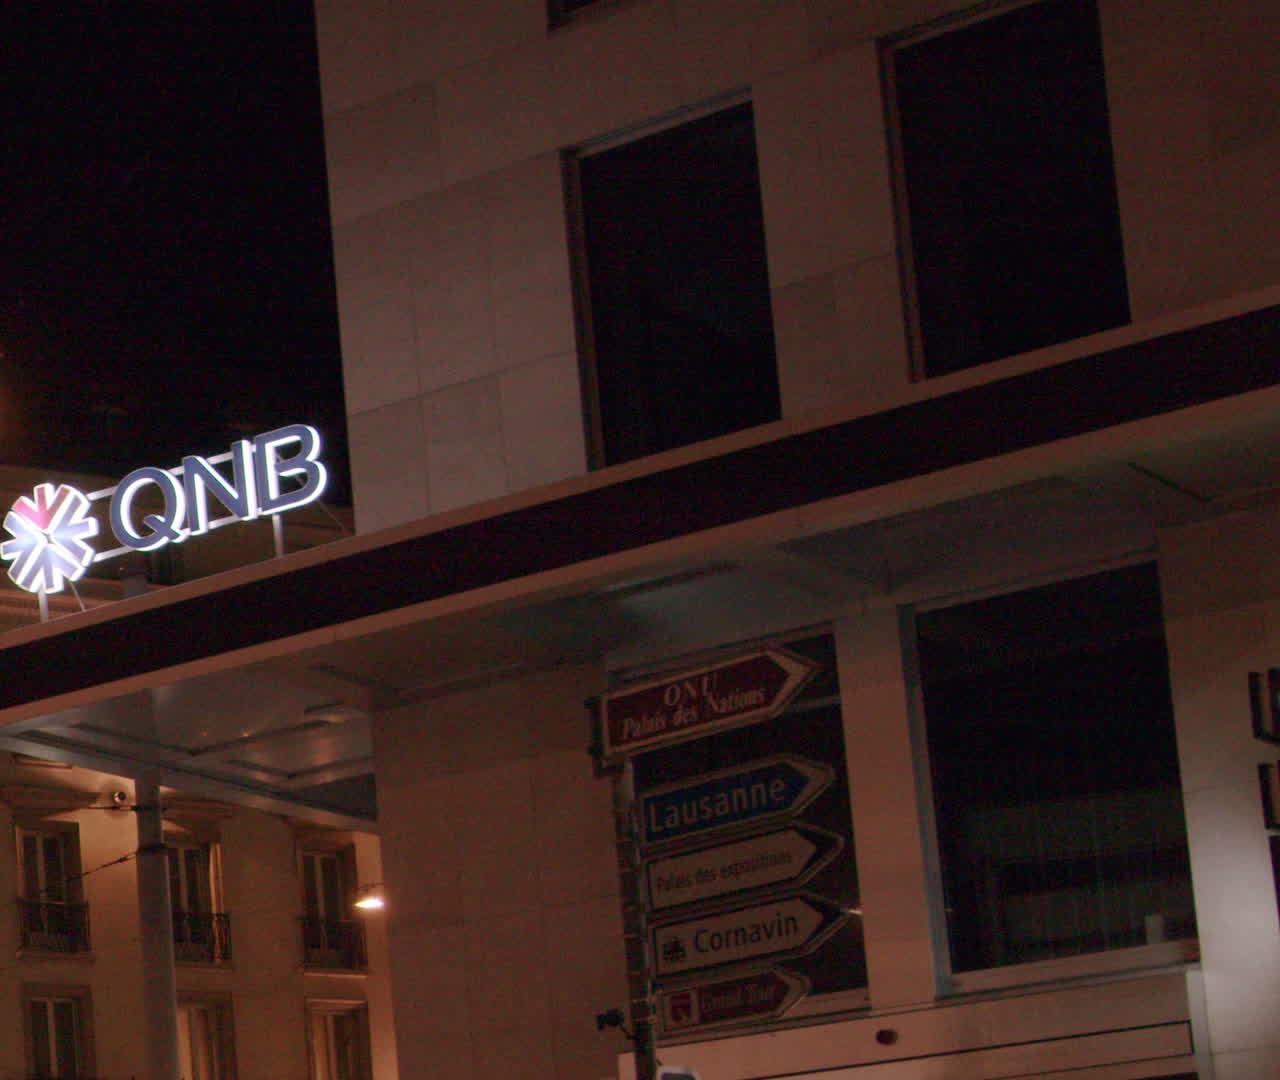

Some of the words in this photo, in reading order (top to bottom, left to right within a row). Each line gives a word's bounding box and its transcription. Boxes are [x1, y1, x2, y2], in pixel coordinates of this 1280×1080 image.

[111, 424, 327, 551] QNB
[619, 710, 666, 739] Palais
[673, 703, 698, 726] des
[704, 687, 766, 713] Nations
[663, 672, 718, 706] ONU
[648, 775, 786, 832] Lausanne
[694, 911, 799, 953] Cornavin
